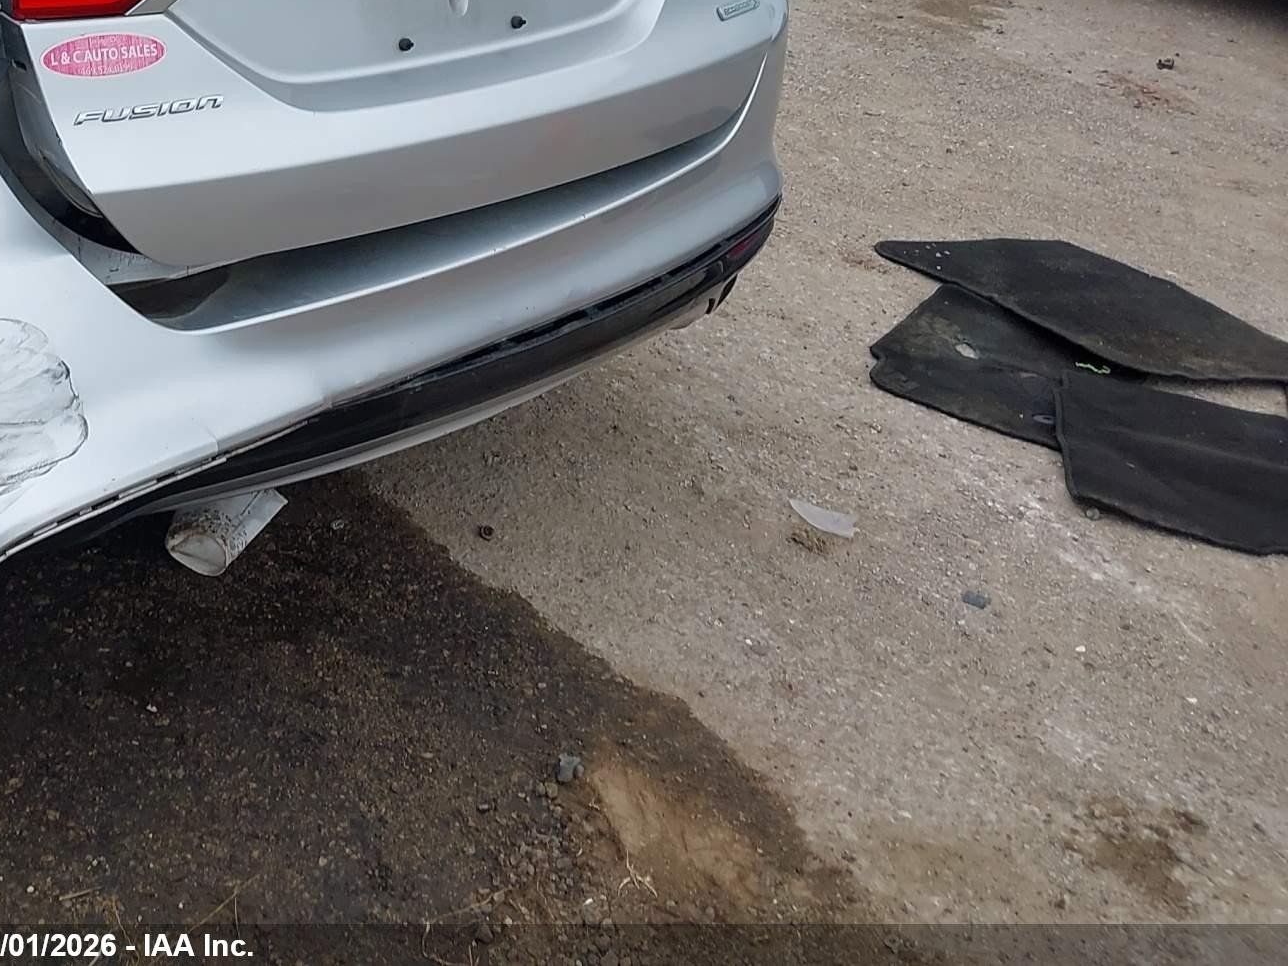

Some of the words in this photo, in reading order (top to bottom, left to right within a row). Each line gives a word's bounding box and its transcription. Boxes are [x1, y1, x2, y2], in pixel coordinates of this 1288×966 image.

[50, 52, 59, 66] L
[60, 51, 71, 65] &
[72, 48, 82, 63] C
[83, 47, 118, 64] AUTO
[121, 43, 158, 59] SALES
